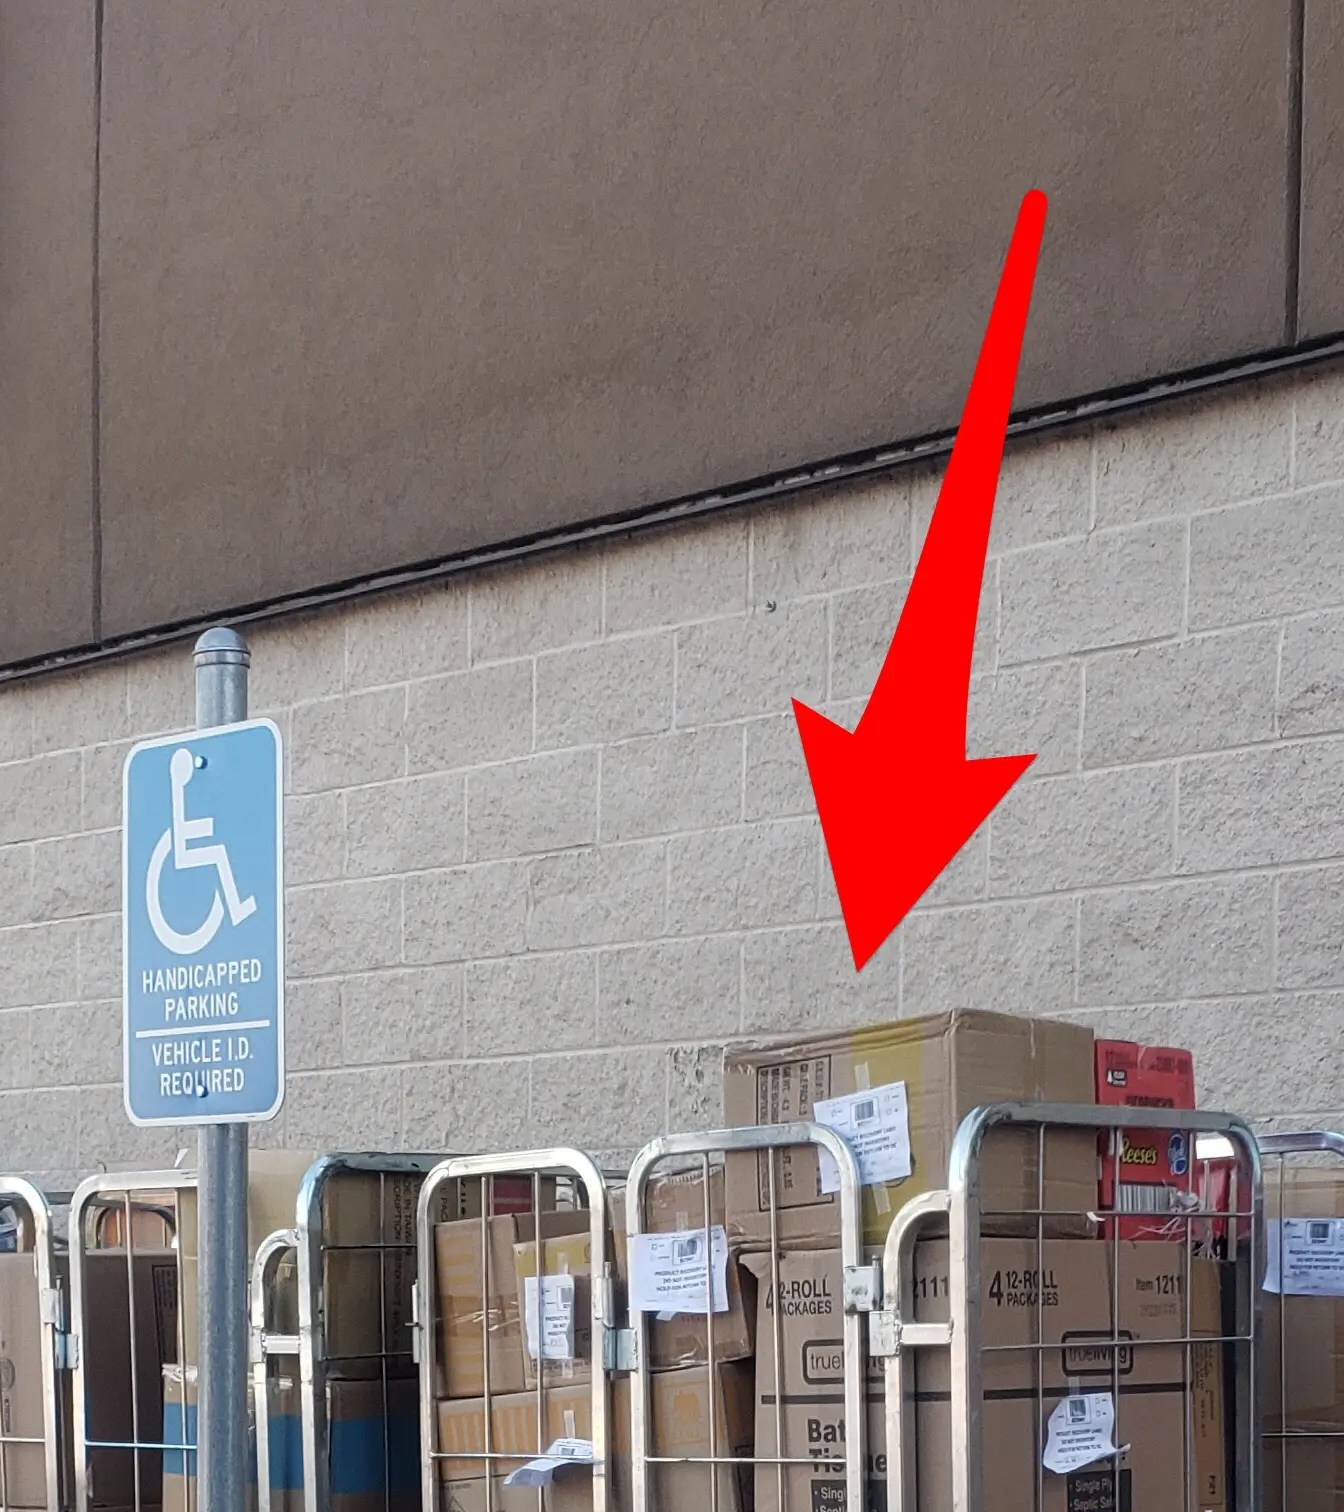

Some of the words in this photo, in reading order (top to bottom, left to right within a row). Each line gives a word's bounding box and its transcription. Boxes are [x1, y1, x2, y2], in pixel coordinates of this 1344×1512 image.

[142, 958, 262, 994] HANDICAPPED
[164, 991, 239, 1022] PARKING
[152, 1037, 224, 1067] VEHICLE
[227, 1035, 254, 1062] I.D.
[160, 1066, 245, 1096] REQUIRED
[780, 1278, 832, 1300] 2-ROLL
[989, 1271, 1004, 1308] 4
[1006, 1269, 1058, 1290] 12-ROLL
[1155, 1274, 1183, 1295] 1211
[780, 1300, 832, 1317] ACKAGES
[1006, 1291, 1059, 1307] PACKAGES
[807, 1418, 846, 1443] Bat
[821, 1487, 847, 1503] Singl
[1075, 1478, 1101, 1494] Single
[1073, 1498, 1099, 1512] Septic
